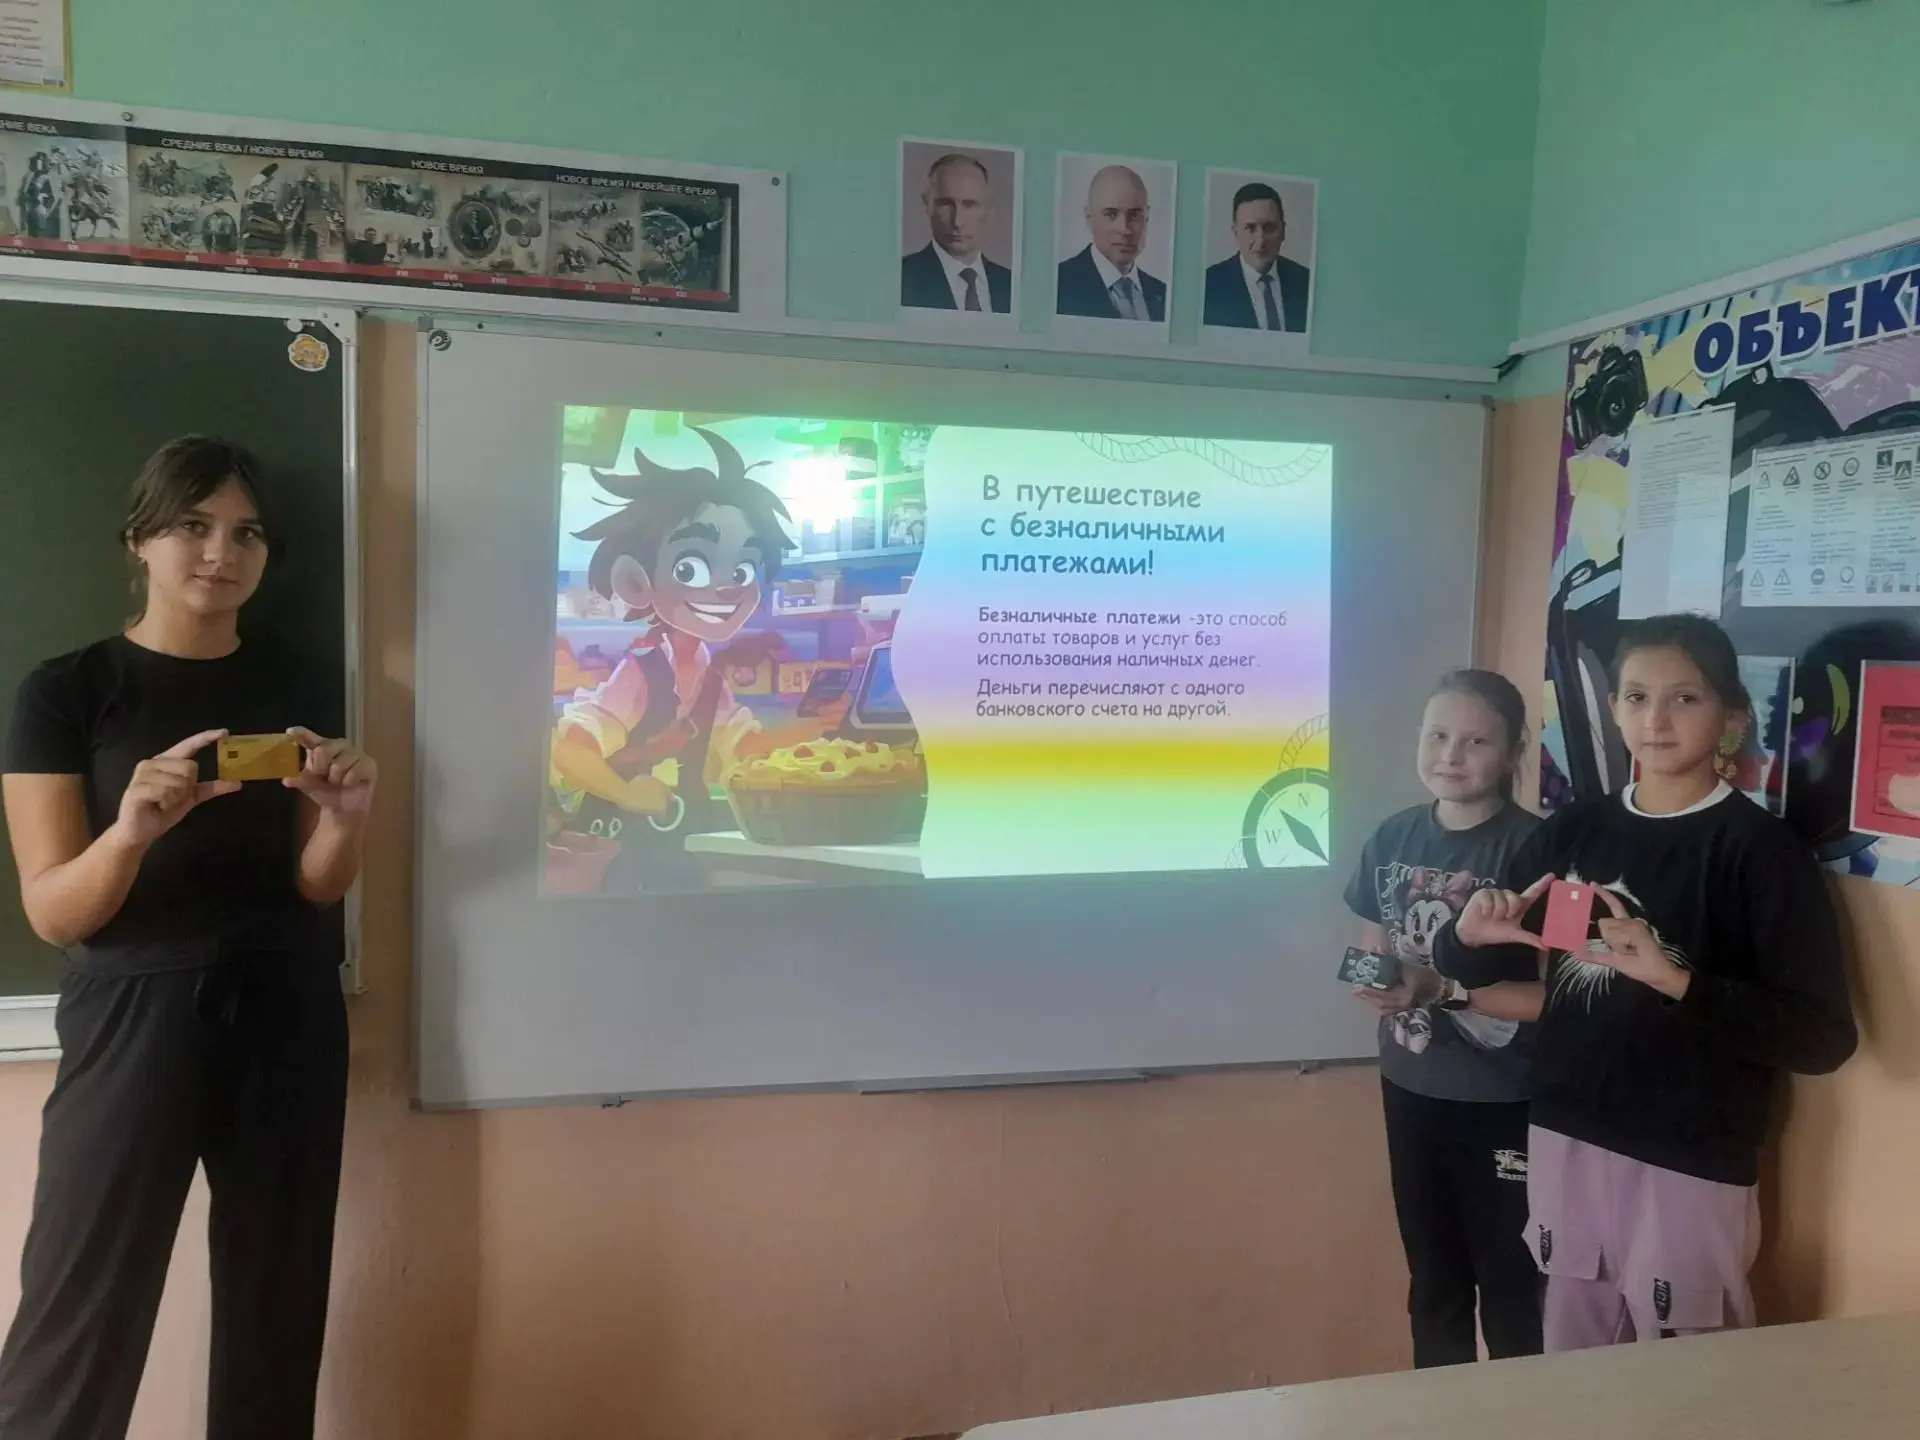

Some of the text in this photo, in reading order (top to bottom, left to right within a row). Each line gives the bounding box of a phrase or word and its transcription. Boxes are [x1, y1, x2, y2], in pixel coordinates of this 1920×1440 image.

[27, 122, 58, 134] ВЕКА
[161, 138, 212, 150] СРЕДНИЕ
[215, 143, 243, 153] ВЕКА
[250, 145, 286, 157] НОВОЕ
[288, 148, 324, 159] ВРЕМЯ
[411, 160, 484, 175] НОВОЕ ВРЕМЯ
[556, 174, 588, 185] НОВОЕ
[592, 177, 625, 188] ВРЕМЯ
[631, 180, 682, 194] НОВЕЙШЕЕ
[685, 186, 717, 197] ВРЕМЯ
[1693, 266, 1920, 375] ОБЪЕК
[983, 475, 1202, 511] В путешествие
[980, 511, 1225, 542] с безналичными
[981, 549, 1153, 576] платежами!
[979, 606, 1097, 624] Безналичные
[1106, 612, 1181, 625] платежи
[1229, 611, 1287, 627] способ
[978, 630, 1221, 650] оплаты товаров и услуг без
[977, 652, 1261, 669] использования наличных денег.
[977, 678, 1245, 699] Деньги перечисляют с одного
[976, 700, 1231, 720] банковского счета на другой.
